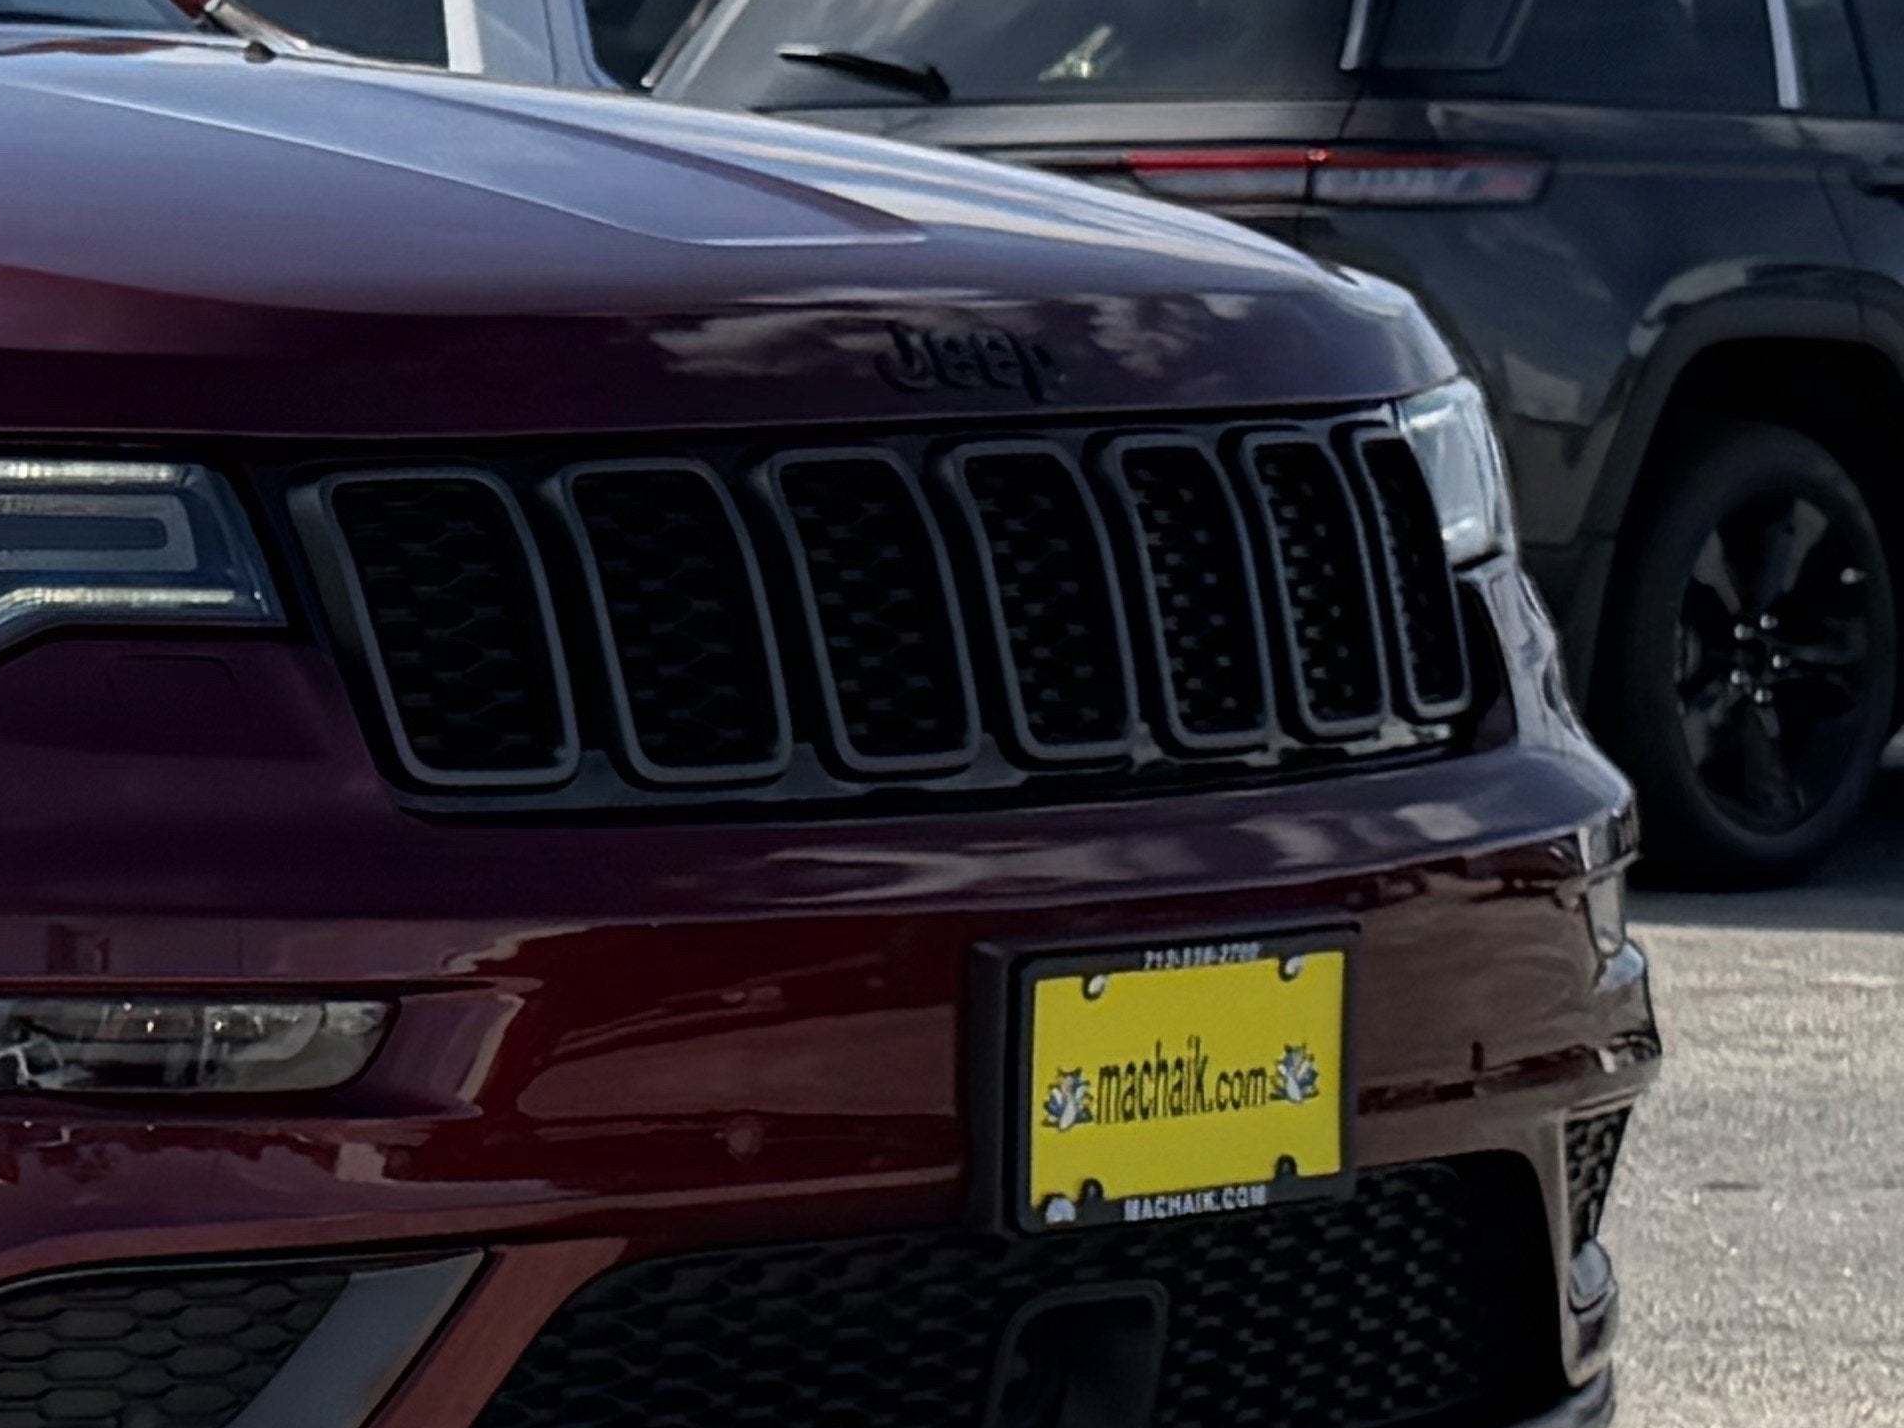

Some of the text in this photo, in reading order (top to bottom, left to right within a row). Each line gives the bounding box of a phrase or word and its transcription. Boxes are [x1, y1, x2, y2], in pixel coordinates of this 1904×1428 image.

[873, 320, 1059, 405] Jeep
[1096, 1034, 1267, 1125] machaik.com
[1123, 1184, 1267, 1222] MACHAIK.COM
